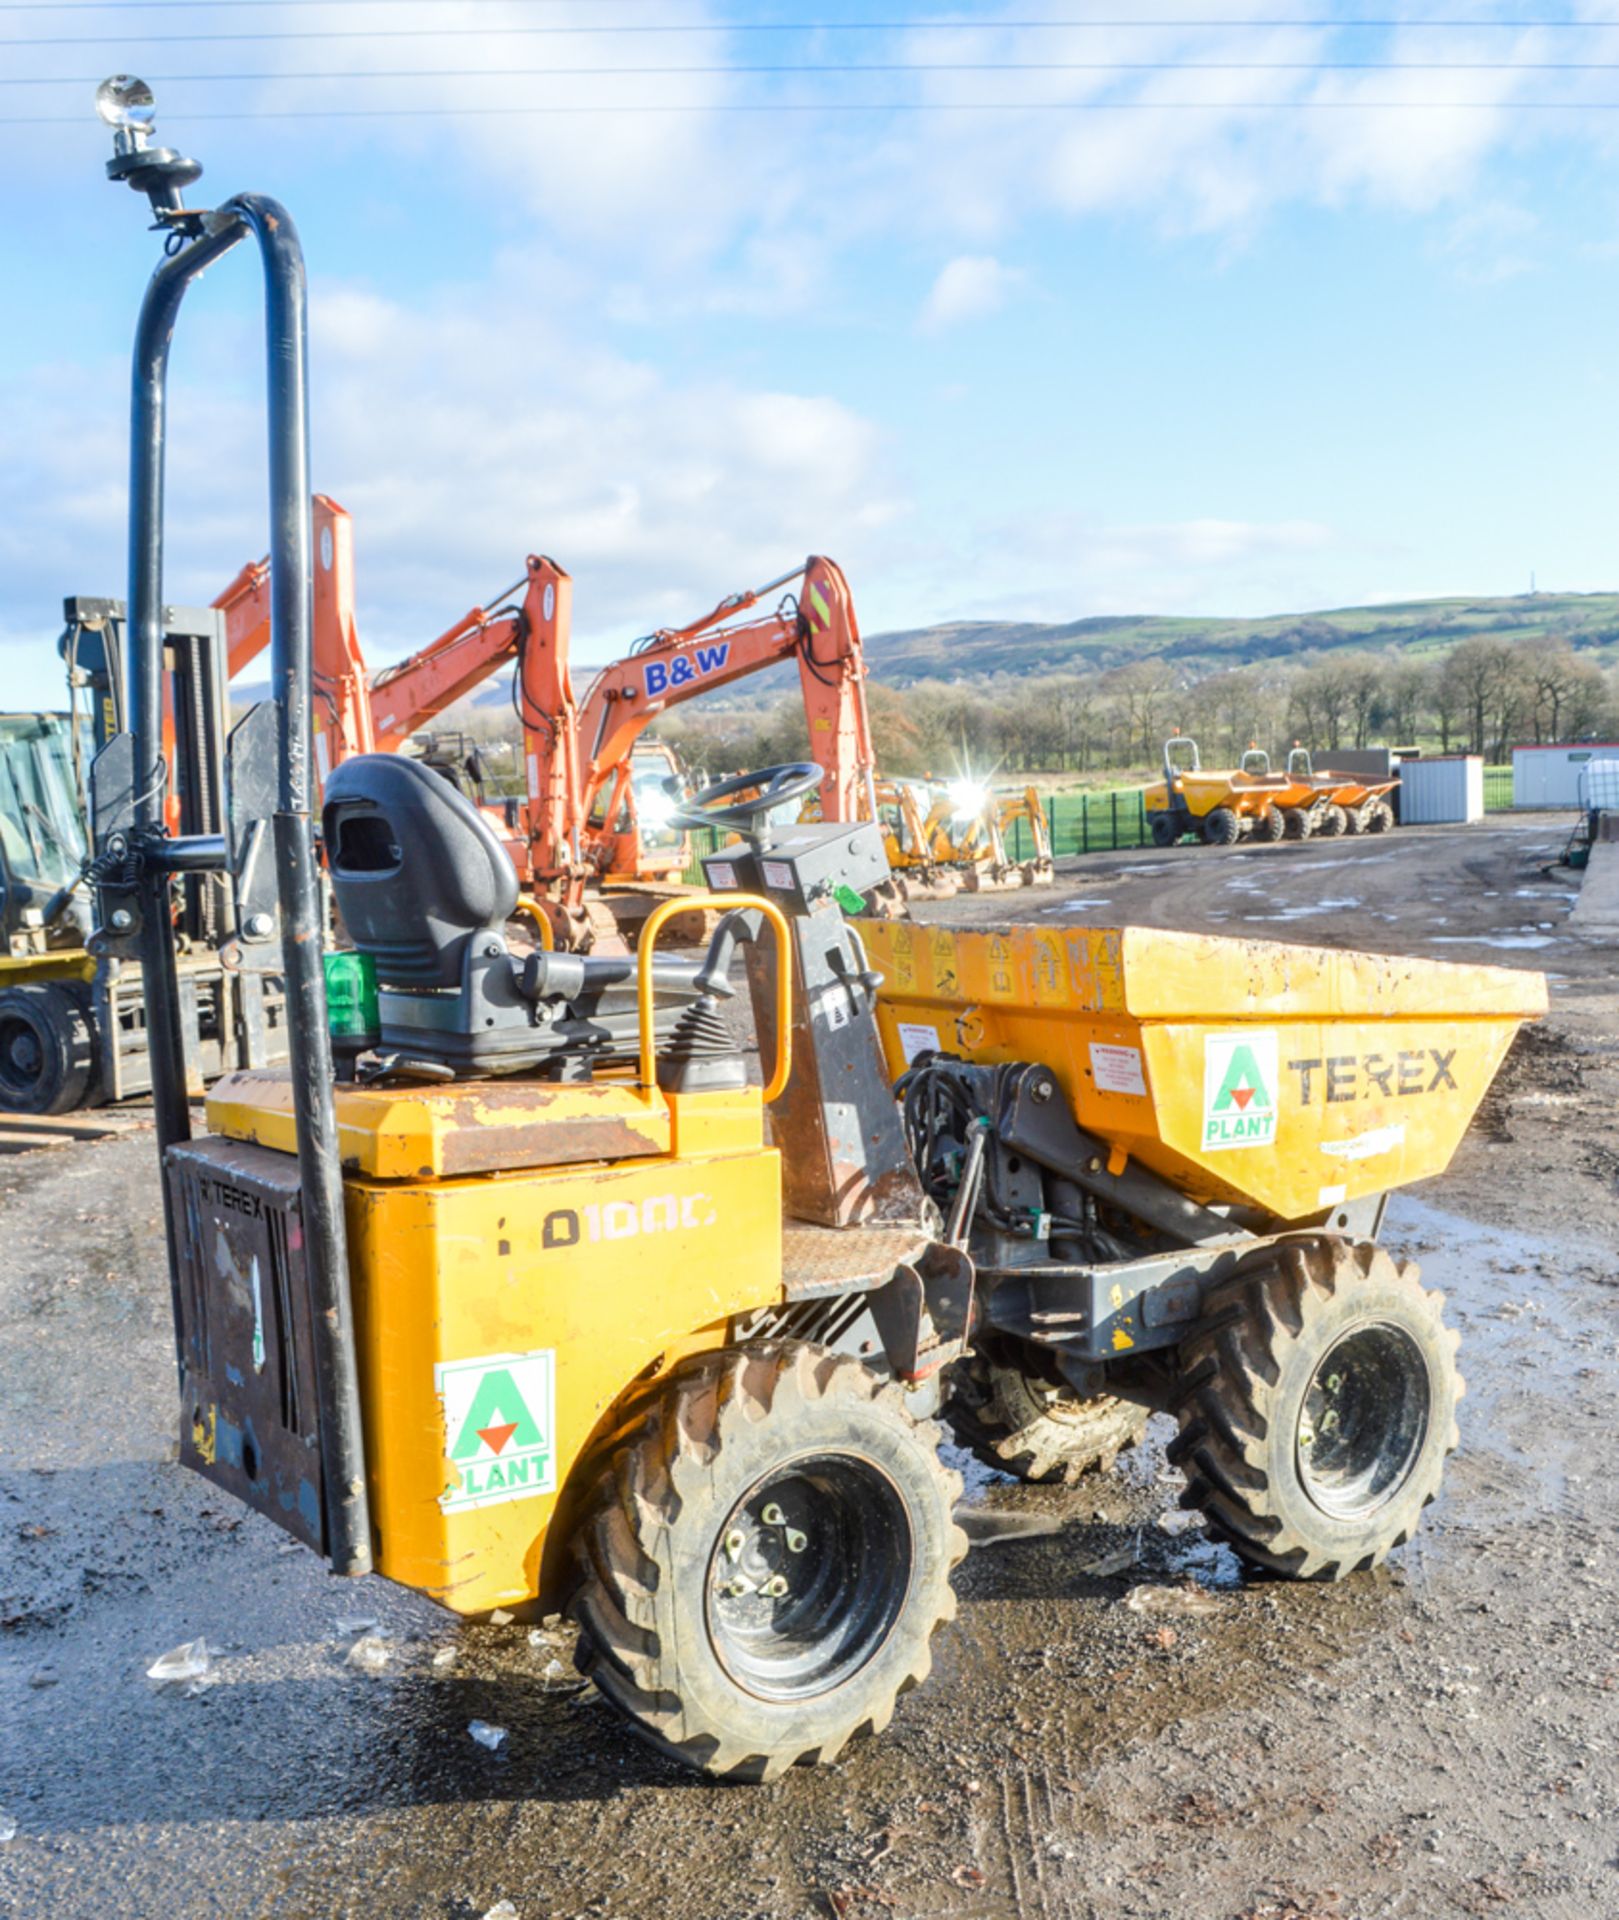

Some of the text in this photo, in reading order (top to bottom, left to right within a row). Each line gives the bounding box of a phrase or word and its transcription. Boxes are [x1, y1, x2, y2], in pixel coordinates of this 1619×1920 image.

[643, 641, 731, 698] B&W
[1287, 1049, 1458, 1107] TEREX
[1206, 1116, 1274, 1141] PLANT
[213, 1180, 264, 1221] TEREX
